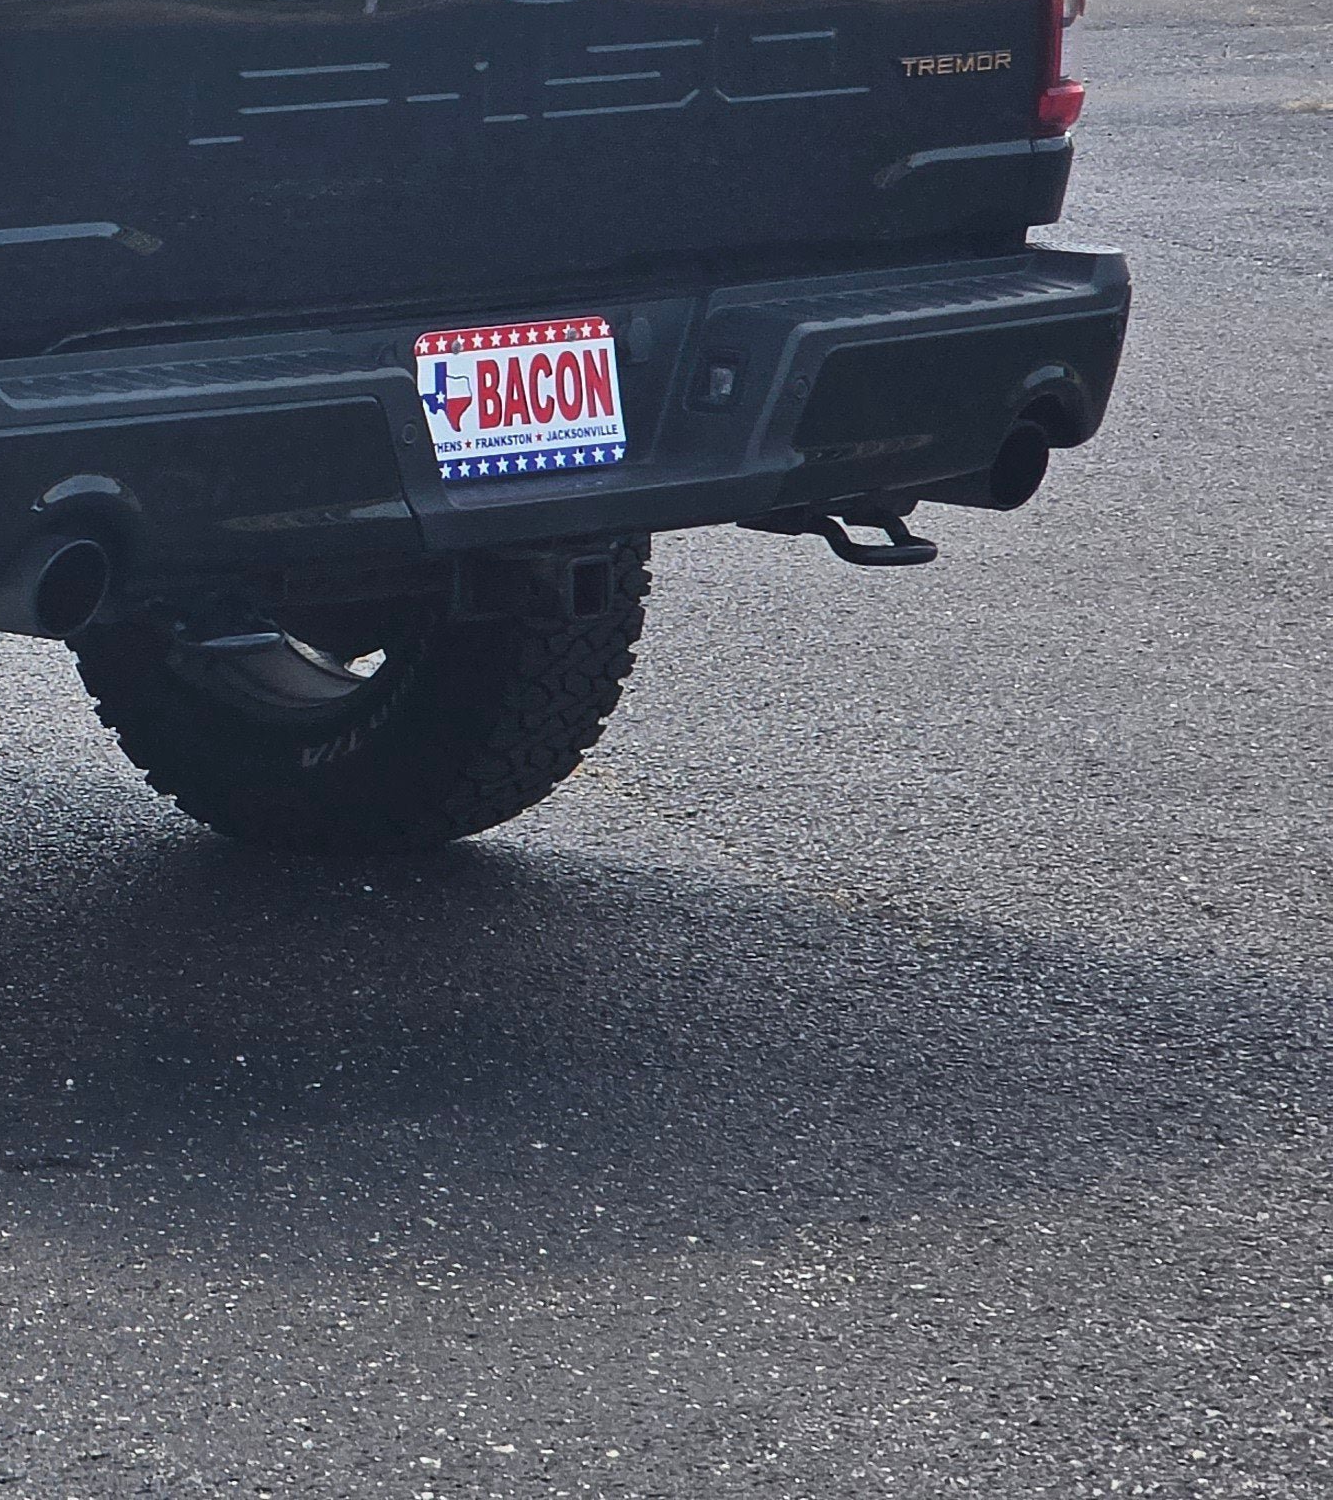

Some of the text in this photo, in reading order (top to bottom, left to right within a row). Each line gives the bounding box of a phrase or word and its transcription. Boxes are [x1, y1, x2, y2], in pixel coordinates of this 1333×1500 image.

[900, 49, 1012, 77] TREMOR
[476, 348, 615, 430] BACON
[475, 432, 533, 450] FRANKSTON
[545, 424, 619, 443] JACKSONVILLE
